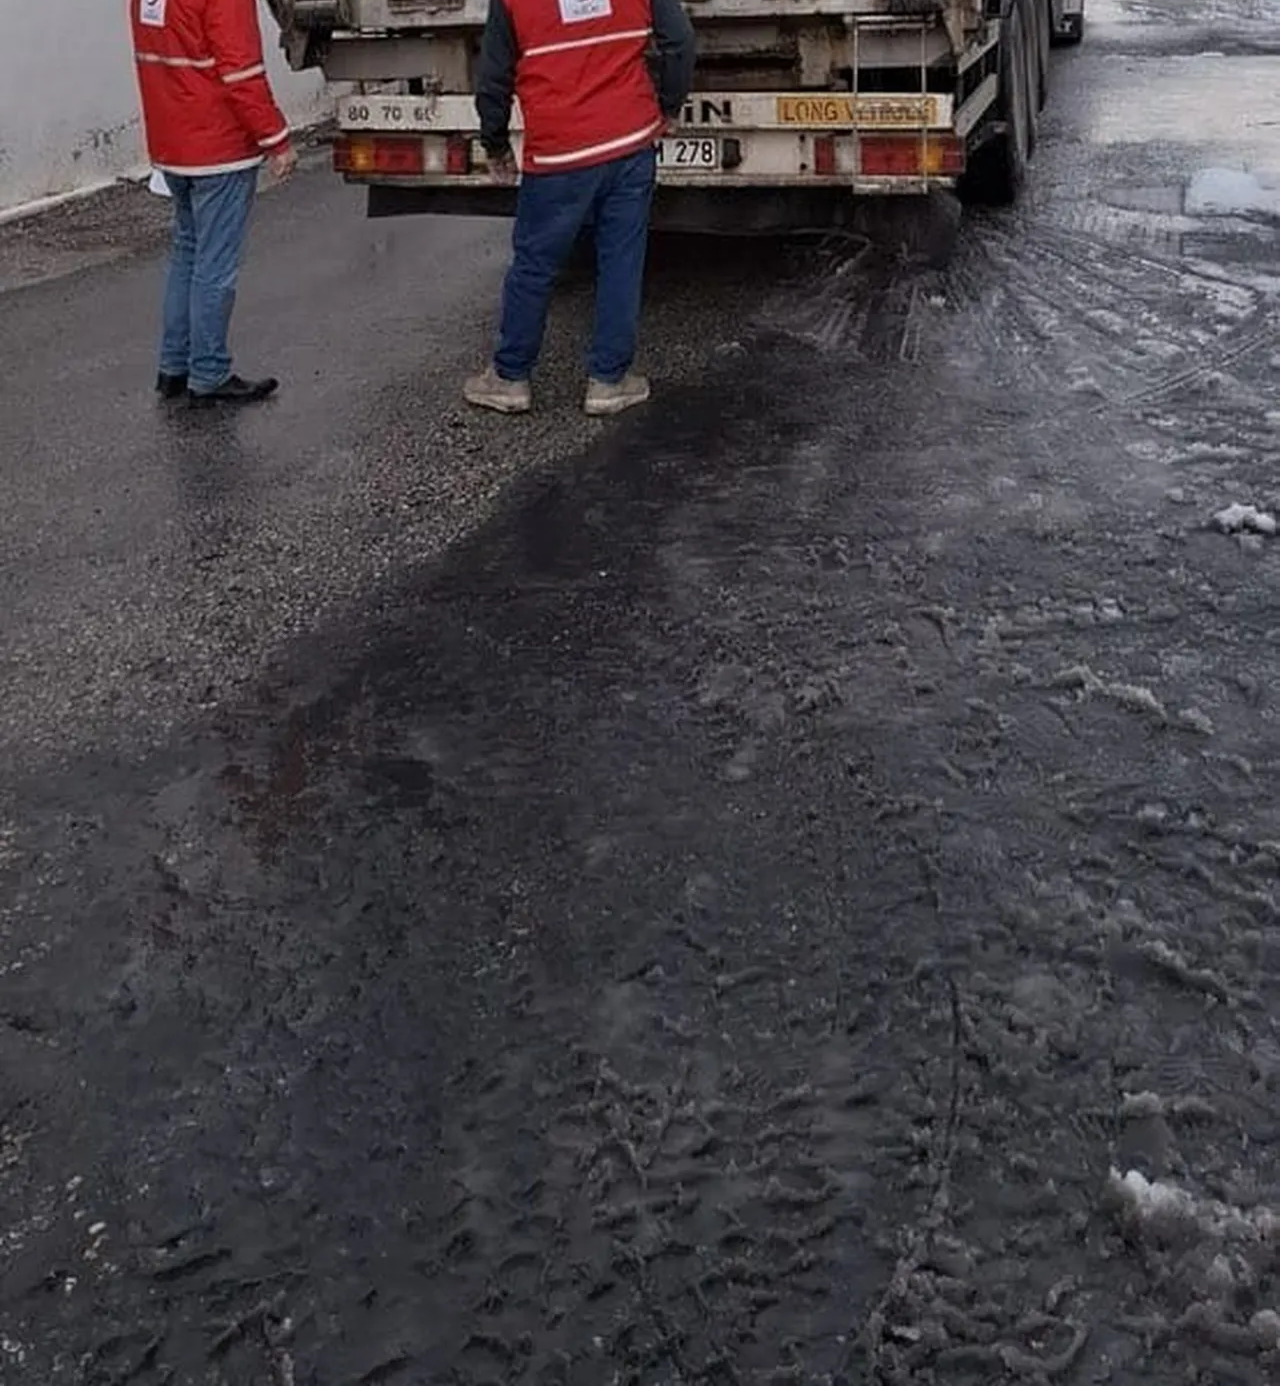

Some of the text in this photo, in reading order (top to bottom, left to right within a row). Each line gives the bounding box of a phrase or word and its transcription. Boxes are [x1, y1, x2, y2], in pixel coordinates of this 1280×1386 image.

[348, 105, 369, 121] 80
[381, 105, 402, 121] 70
[783, 101, 838, 121] LONG
[675, 140, 713, 163] 278
